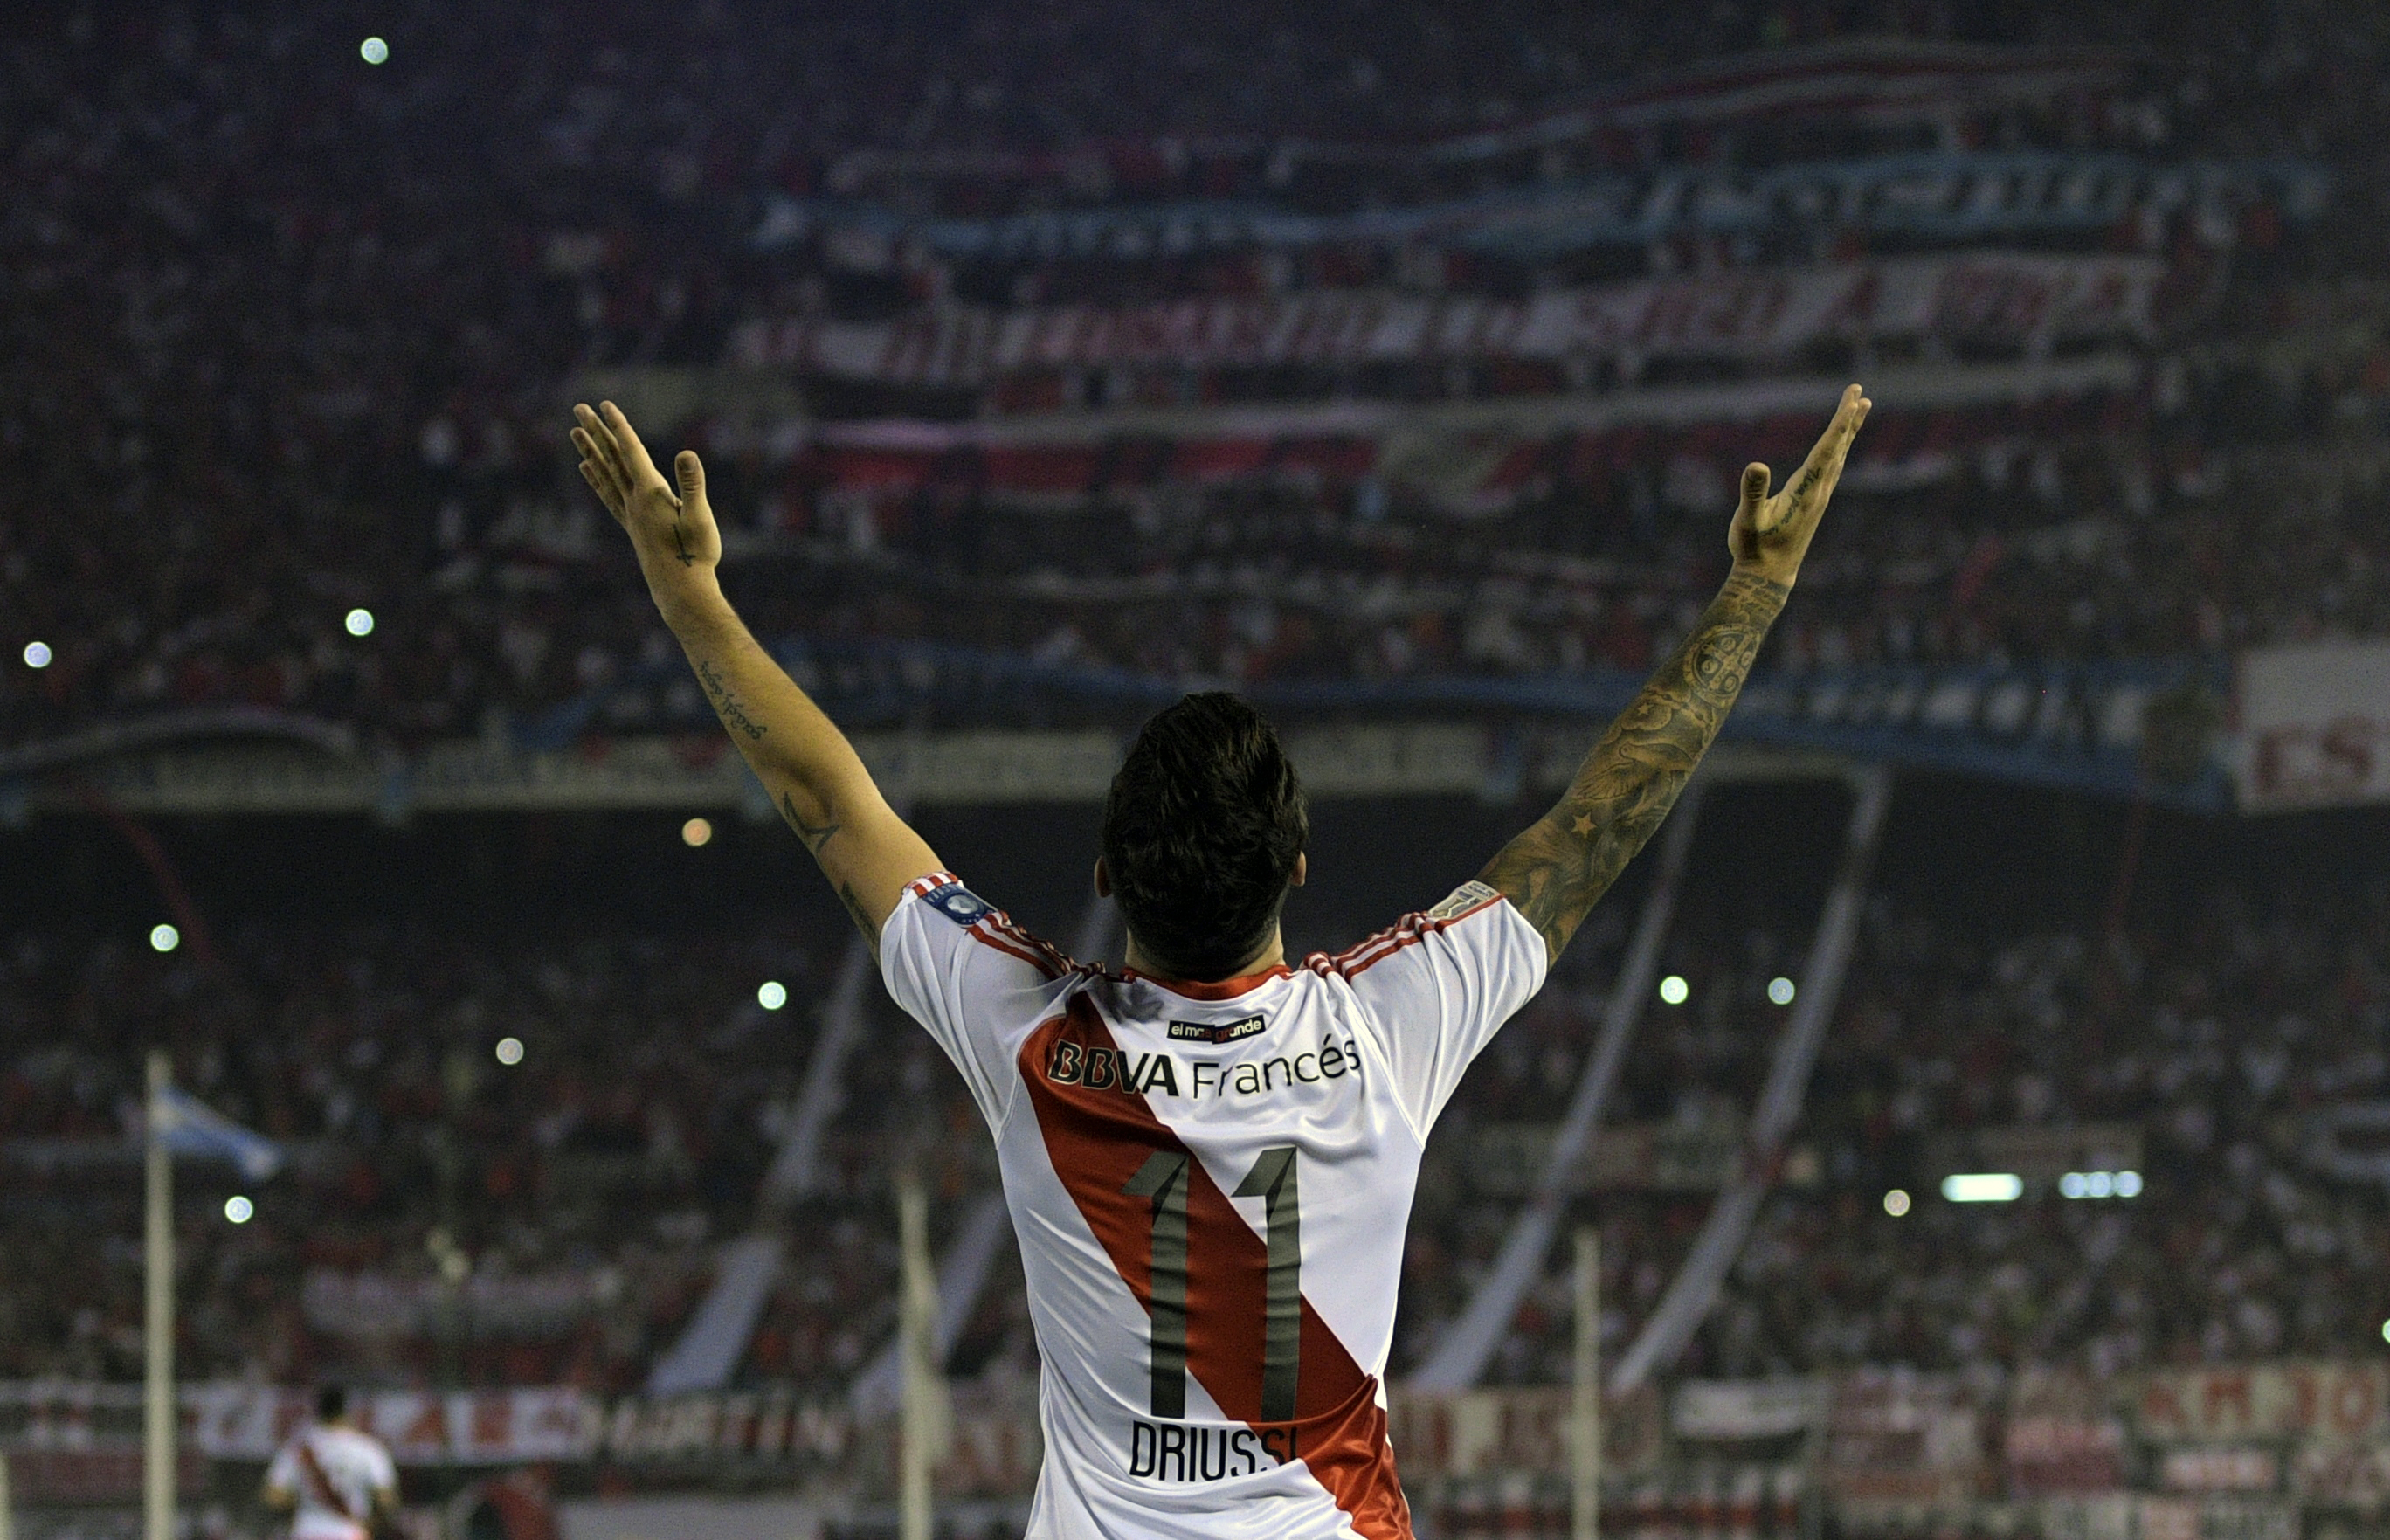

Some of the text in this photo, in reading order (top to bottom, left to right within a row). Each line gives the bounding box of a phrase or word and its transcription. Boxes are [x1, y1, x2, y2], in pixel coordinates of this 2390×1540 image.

[1171, 1023, 1184, 1036] el
[1215, 1019, 1262, 1042] grande
[1048, 1033, 1361, 1099] BBVA Francés
[1120, 1146, 1302, 1422] 11
[1129, 1420, 1298, 1482] DRIUSSI
